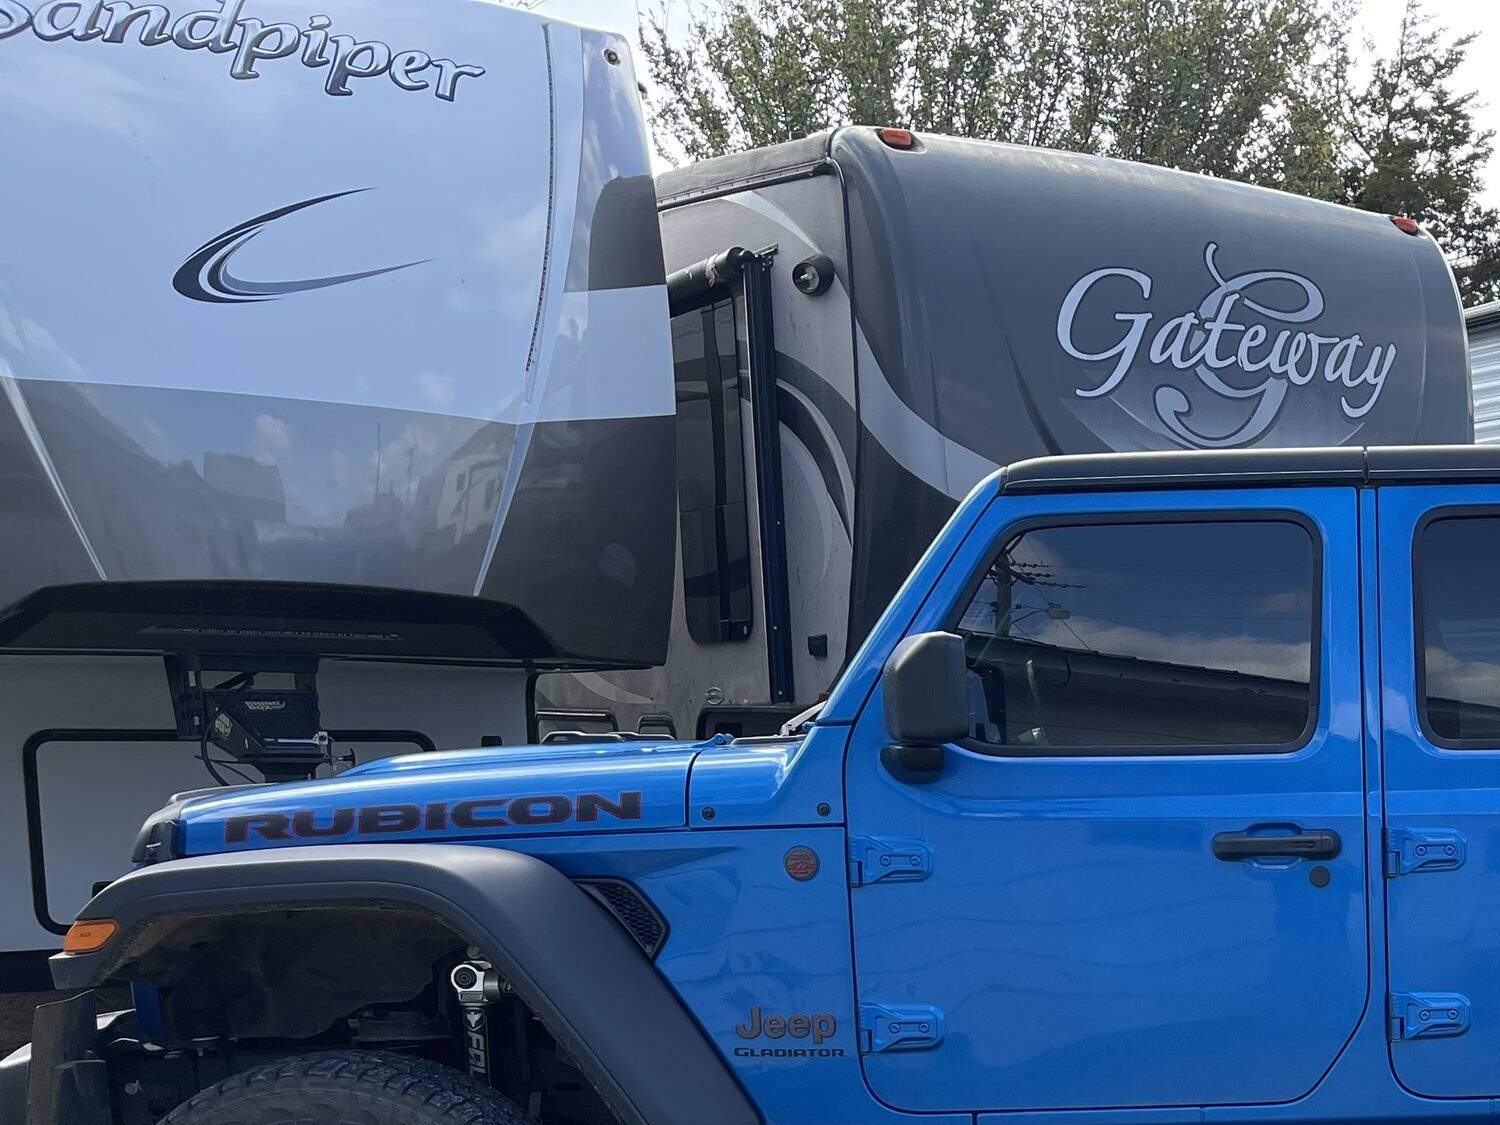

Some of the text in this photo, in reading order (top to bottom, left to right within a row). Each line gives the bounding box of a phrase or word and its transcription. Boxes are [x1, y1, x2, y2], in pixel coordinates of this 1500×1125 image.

[1056, 266, 1398, 419] Gateway
[225, 791, 641, 843] RUBICON
[736, 1006, 837, 1045] Jeep
[733, 1047, 845, 1057] GLADIATOR
